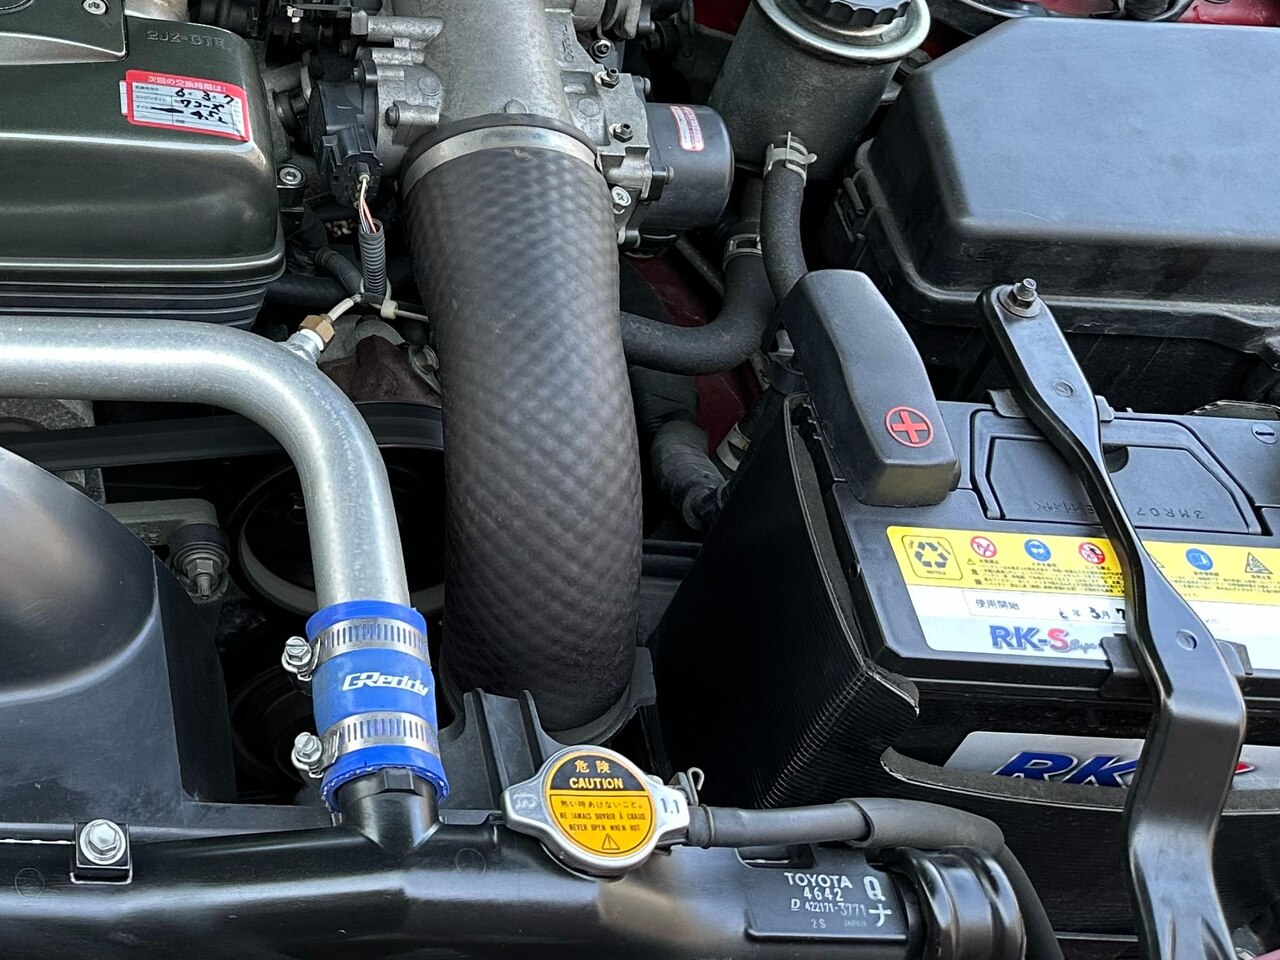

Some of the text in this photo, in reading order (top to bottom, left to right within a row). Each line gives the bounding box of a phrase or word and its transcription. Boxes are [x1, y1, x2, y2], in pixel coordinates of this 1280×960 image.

[146, 29, 225, 51] 2JZ-GTE
[975, 598, 1020, 611] 使用開始
[342, 671, 429, 697] GReddy
[574, 759, 611, 774] 危険
[569, 777, 624, 790] CAUTION
[560, 800, 643, 809] 熱い時あけないこと。
[659, 797, 681, 815] 1.1
[559, 812, 567, 820] NE
[571, 812, 592, 820] JAMAIS
[569, 823, 588, 831] NEVER
[784, 872, 853, 889] TOYOTA
[803, 887, 844, 902] 4642
[805, 901, 867, 917] 422171-3771
